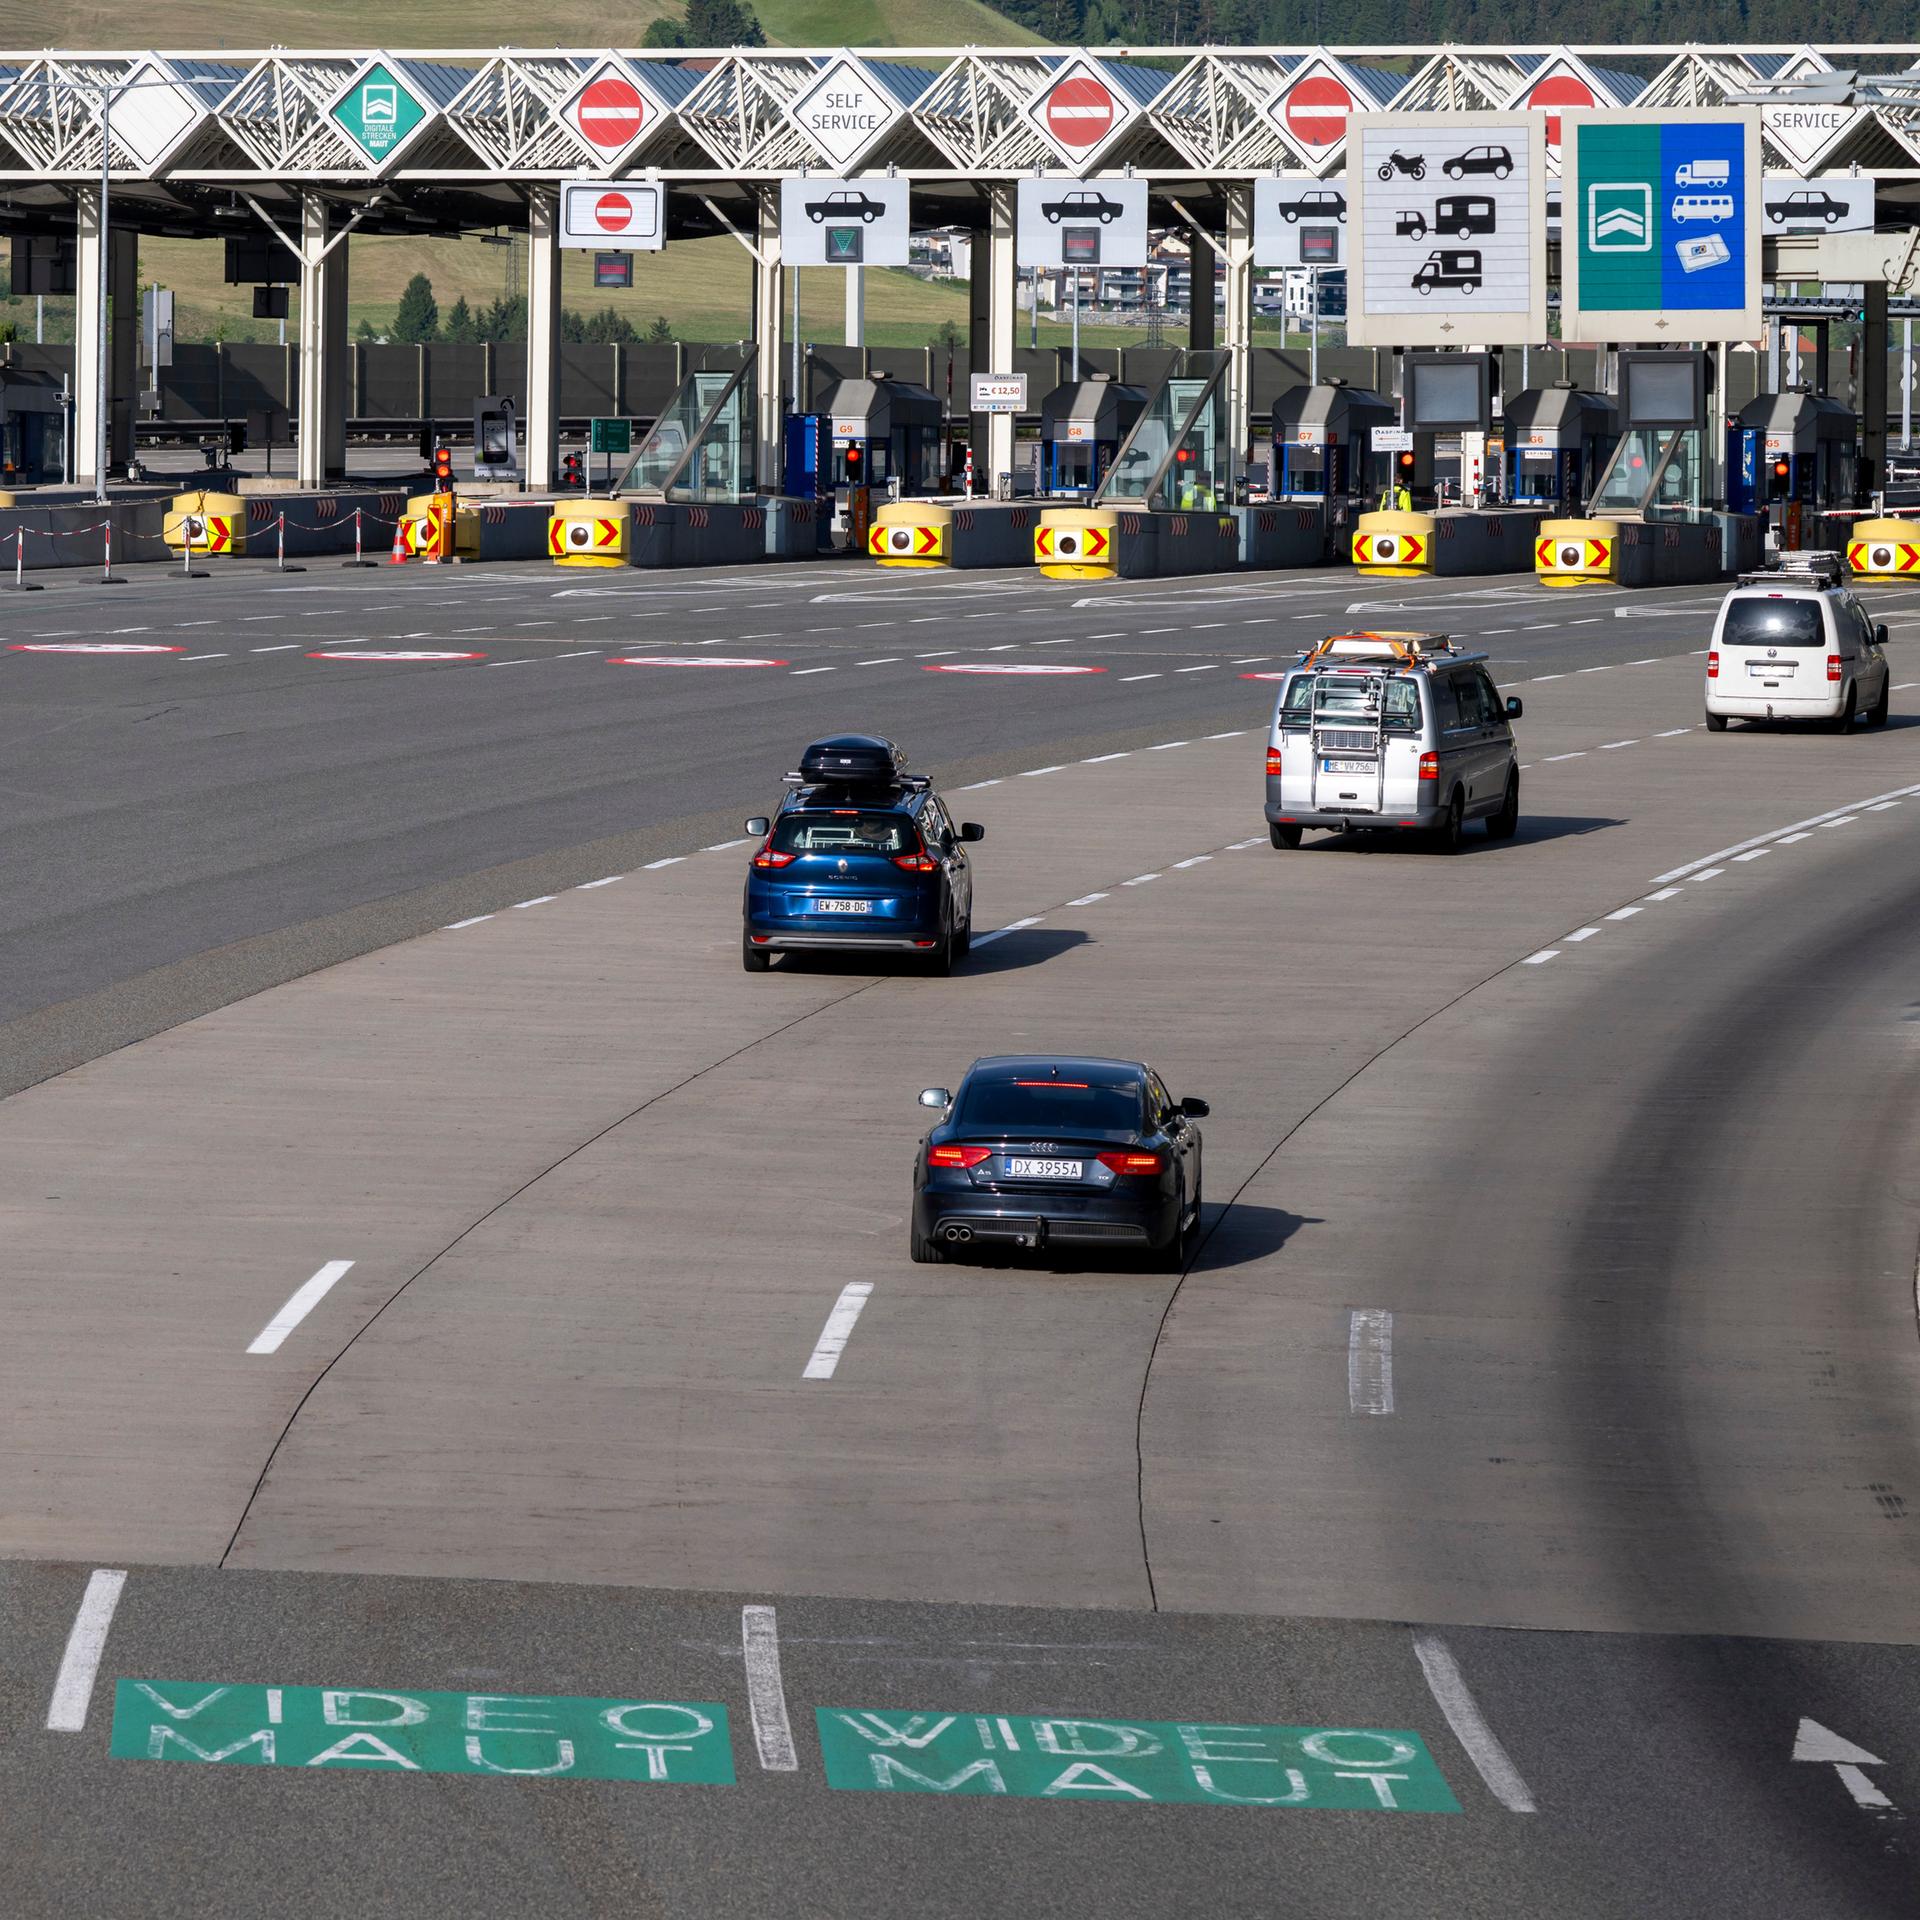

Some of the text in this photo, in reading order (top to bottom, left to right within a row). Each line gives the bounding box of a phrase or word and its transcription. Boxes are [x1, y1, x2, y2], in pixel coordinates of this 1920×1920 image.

[826, 93, 863, 108] SELF
[364, 124, 394, 132] DIGITALE
[812, 114, 876, 129] SERVICE
[1773, 113, 1840, 128] SERVICE
[361, 132, 397, 140] STRECKEN
[998, 387, 1020, 396] 12,50
[839, 425, 853, 433] G9
[1069, 428, 1082, 436] G8
[1299, 432, 1313, 440] G7
[1531, 435, 1544, 444] G6
[1014, 1160, 1078, 1175] DX 3955A
[133, 1682, 714, 1740] VIDEO
[833, 1712, 1418, 1768] VIDEO
[146, 1724, 693, 1780] MAUT
[869, 1753, 1410, 1808] MAUT
